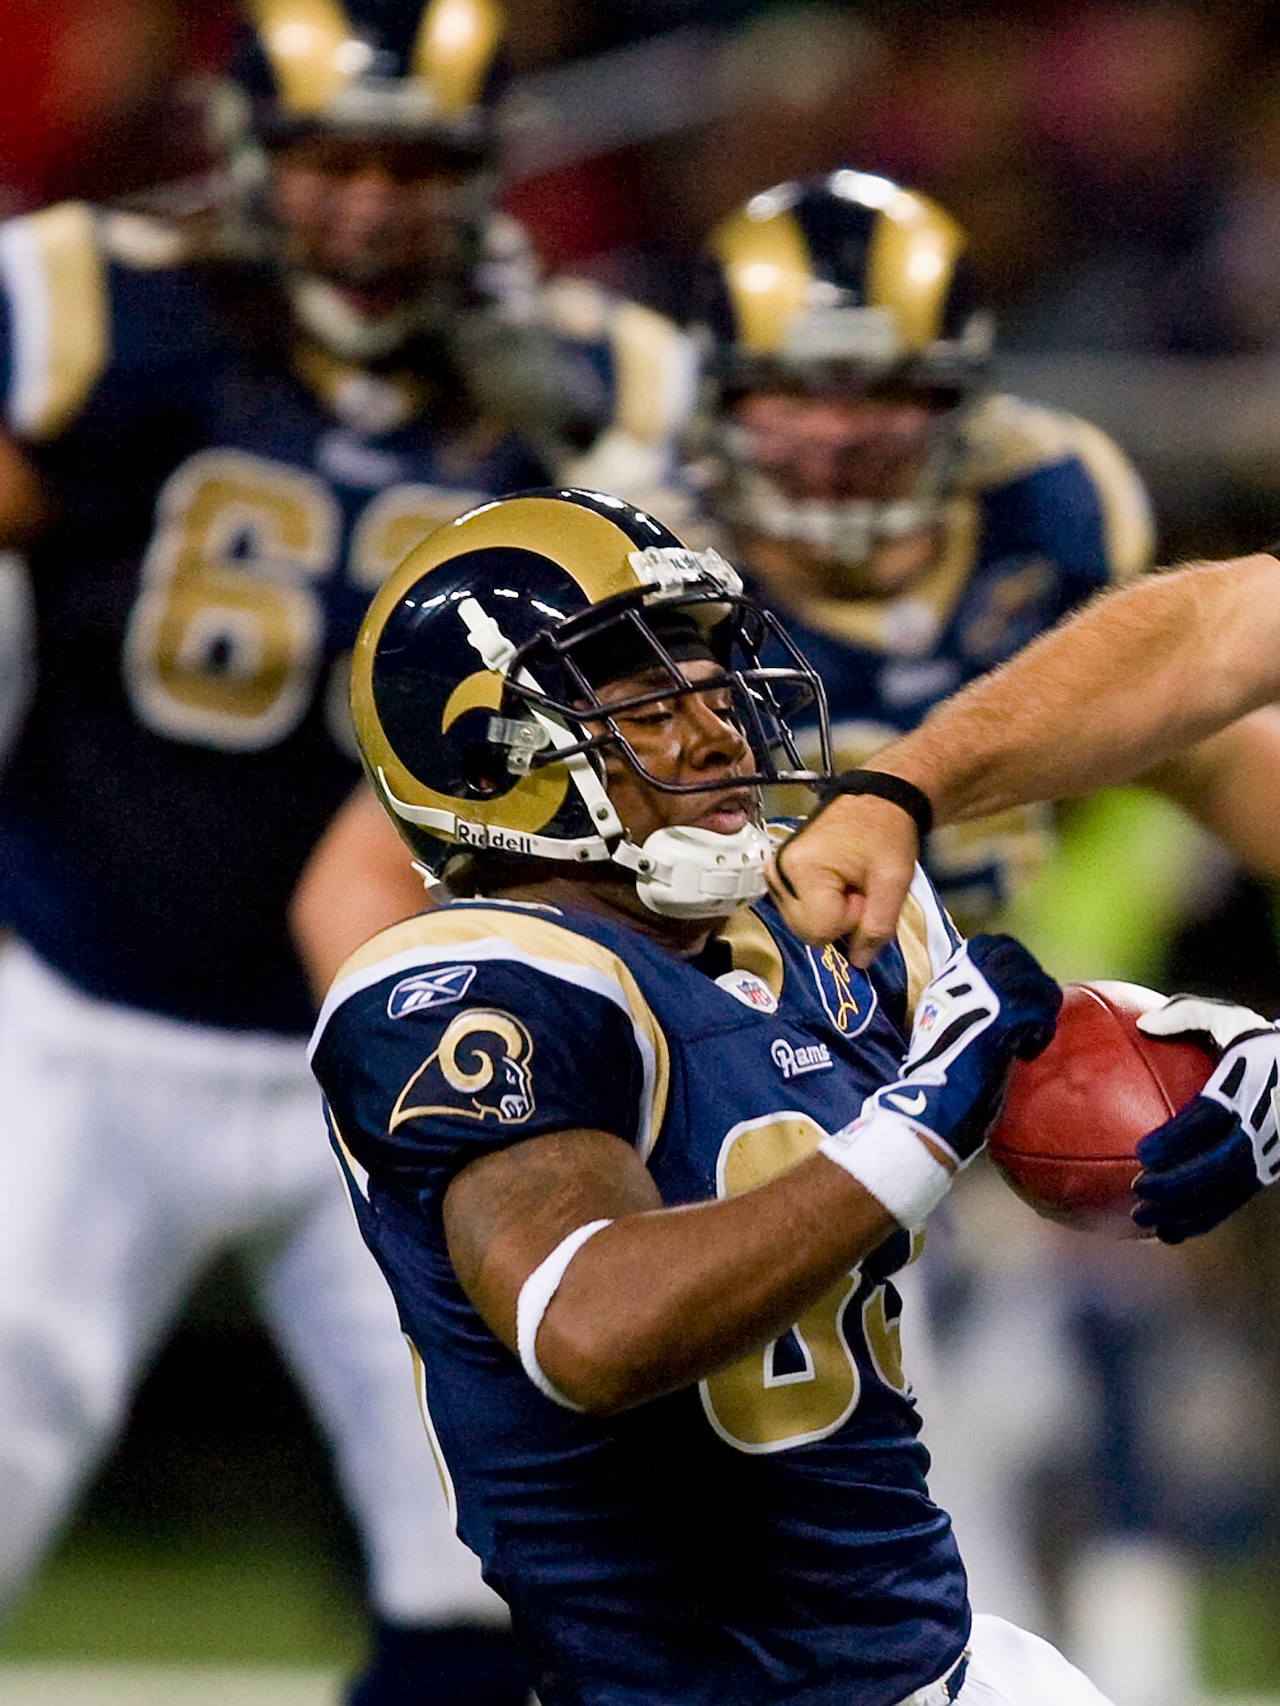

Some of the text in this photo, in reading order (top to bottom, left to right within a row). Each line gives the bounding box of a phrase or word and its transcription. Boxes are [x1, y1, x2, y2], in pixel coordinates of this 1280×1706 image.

[458, 824, 532, 854] Riddell
[770, 1038, 834, 1079] Rams
[699, 1110, 925, 1455] 8
